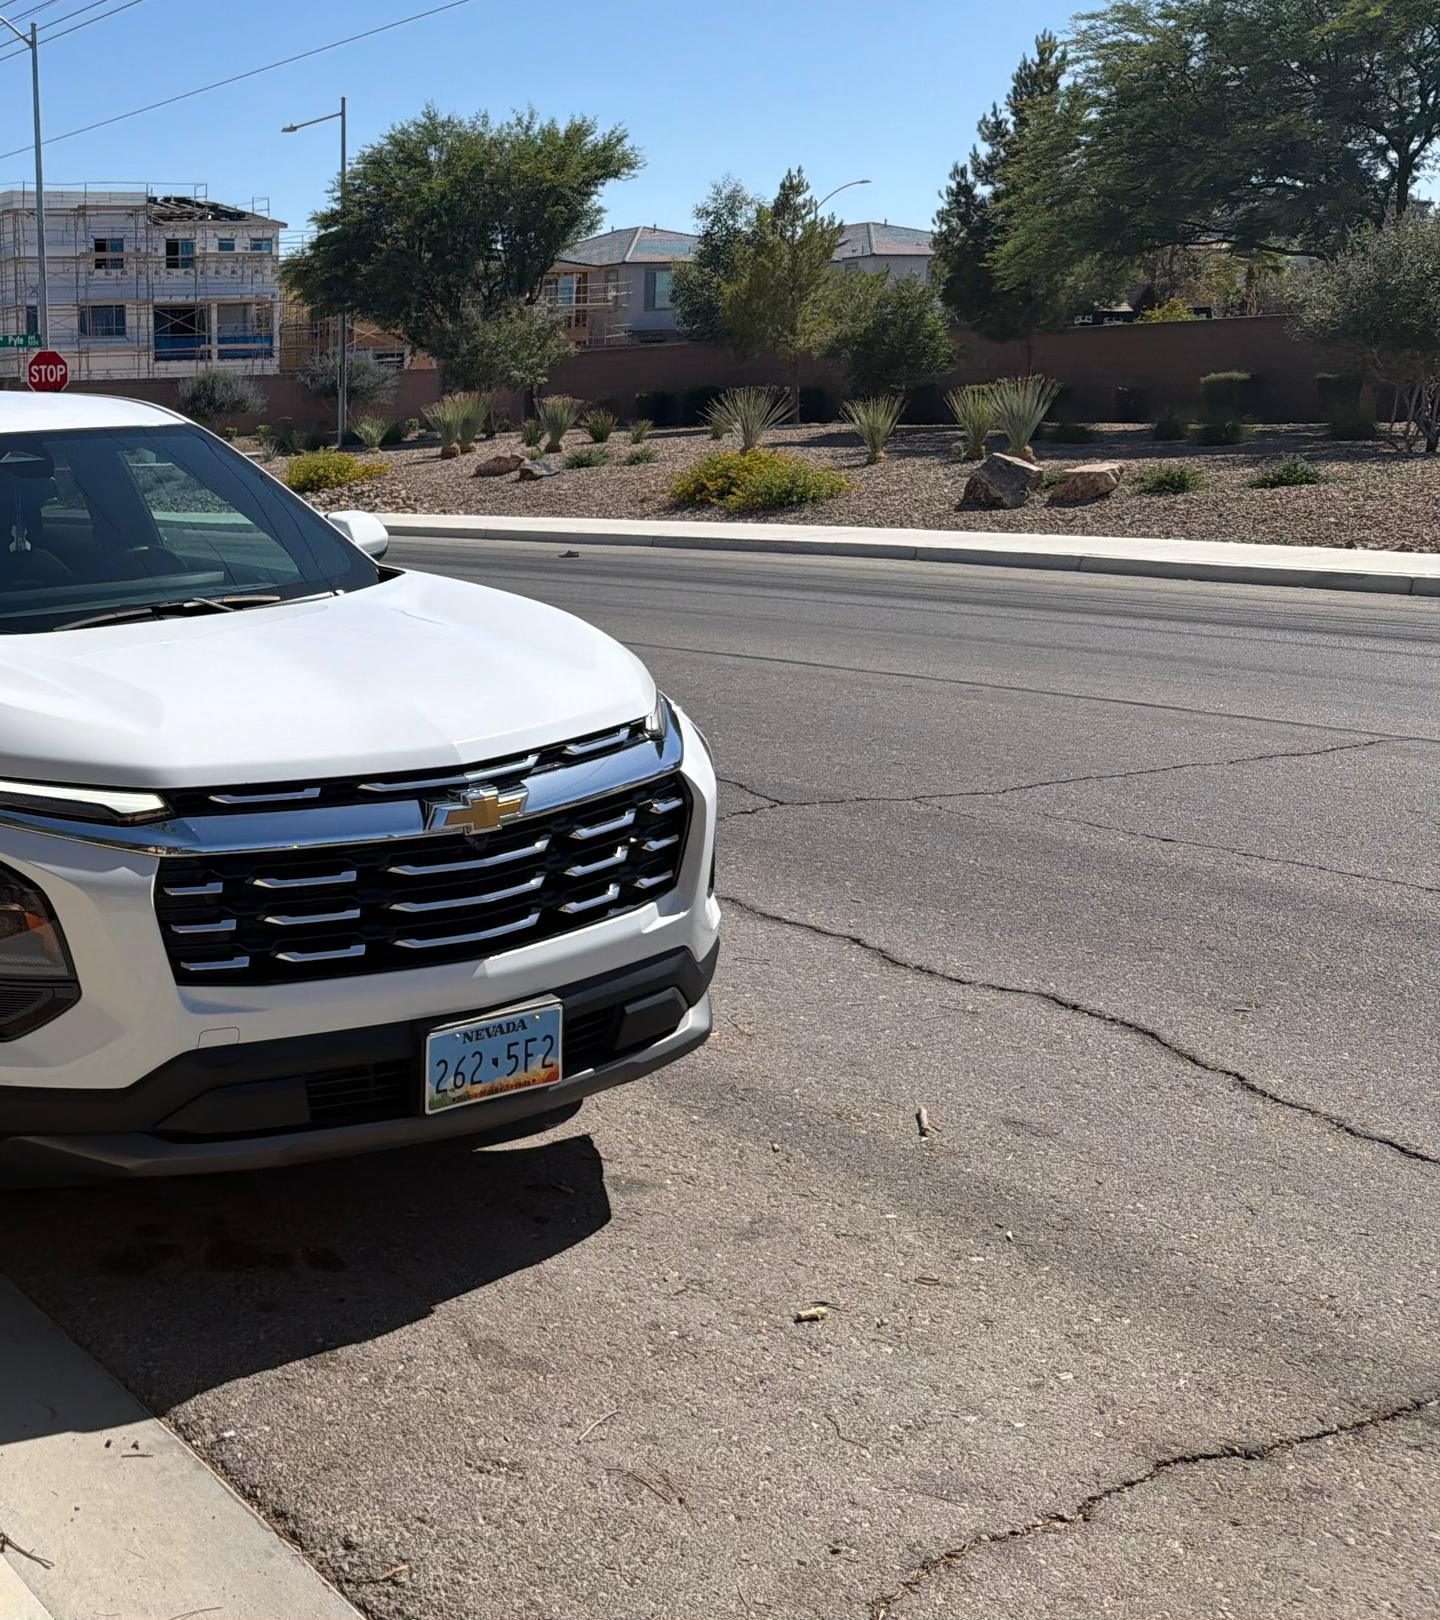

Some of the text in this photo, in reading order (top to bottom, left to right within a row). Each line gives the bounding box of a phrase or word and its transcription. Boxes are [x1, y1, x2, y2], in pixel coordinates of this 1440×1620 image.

[8, 335, 24, 347] Pyle
[30, 364, 66, 383] STOP
[462, 1018, 528, 1045] NEVADA
